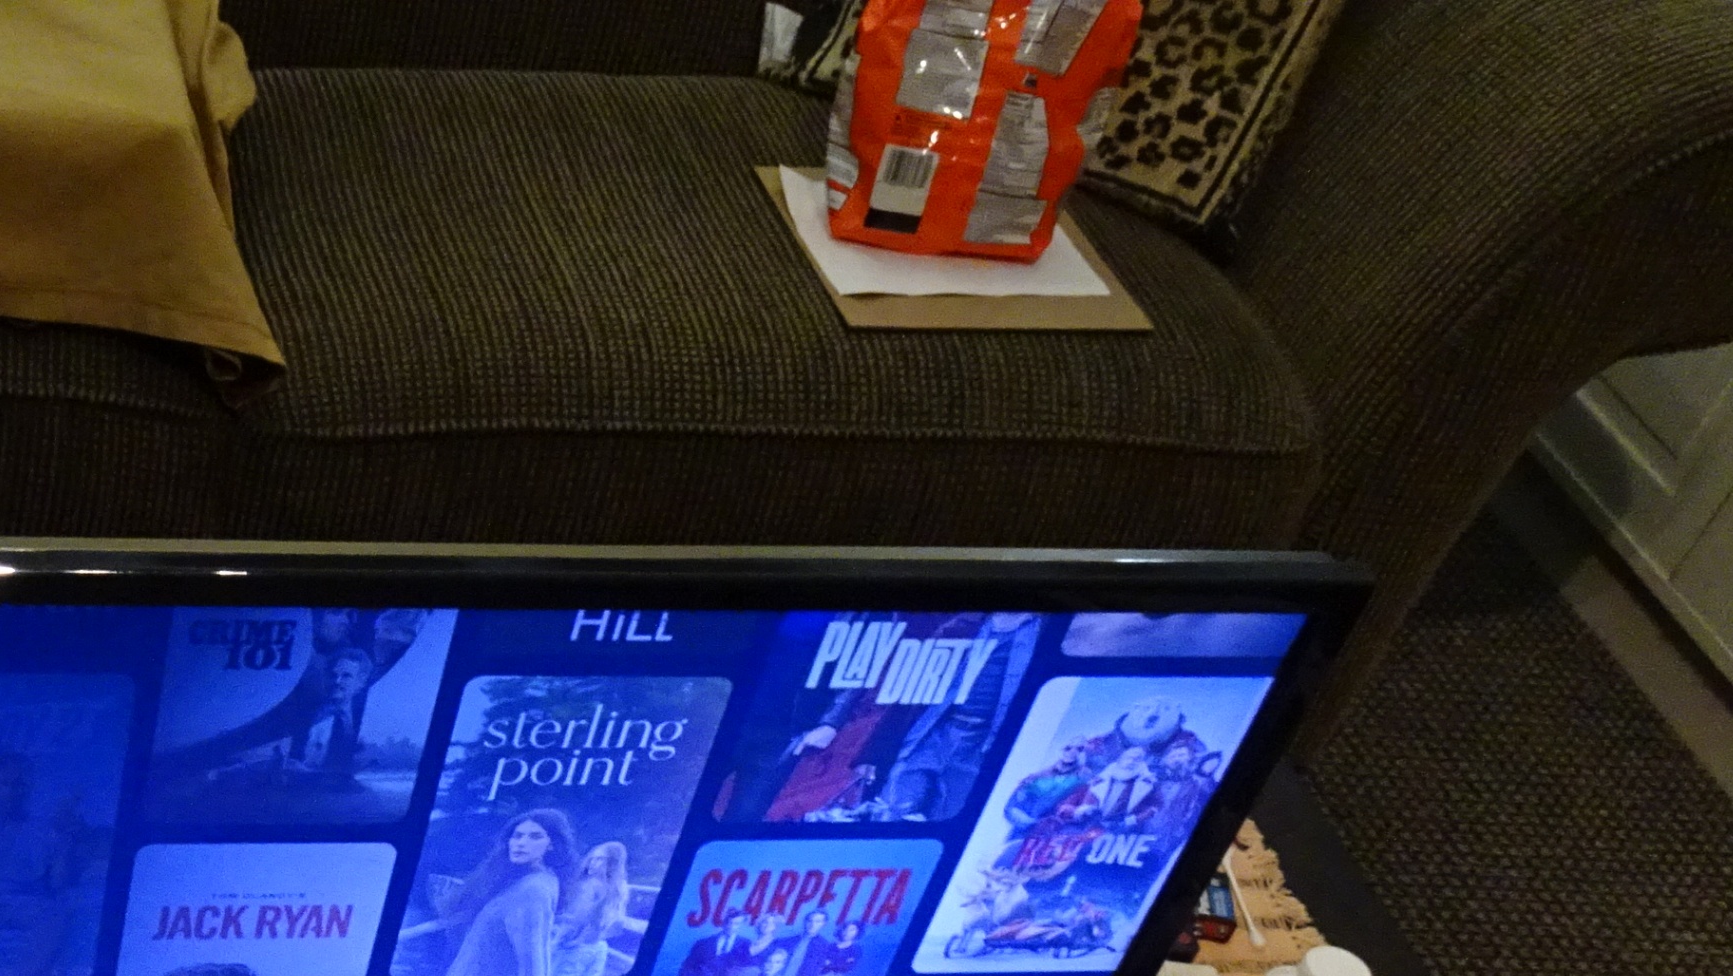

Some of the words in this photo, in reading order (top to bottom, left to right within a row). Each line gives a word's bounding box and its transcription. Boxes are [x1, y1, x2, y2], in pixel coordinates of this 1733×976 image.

[570, 609, 673, 641] HILL
[224, 642, 292, 671] 101
[806, 619, 906, 689] PLAY
[876, 636, 999, 705] DIRTY
[482, 703, 689, 761] sterling
[486, 752, 637, 801] point
[1086, 833, 1157, 868] ONE
[153, 904, 249, 940] JACK
[254, 904, 353, 939] RYAN
[687, 867, 912, 928] SCARPETTA
